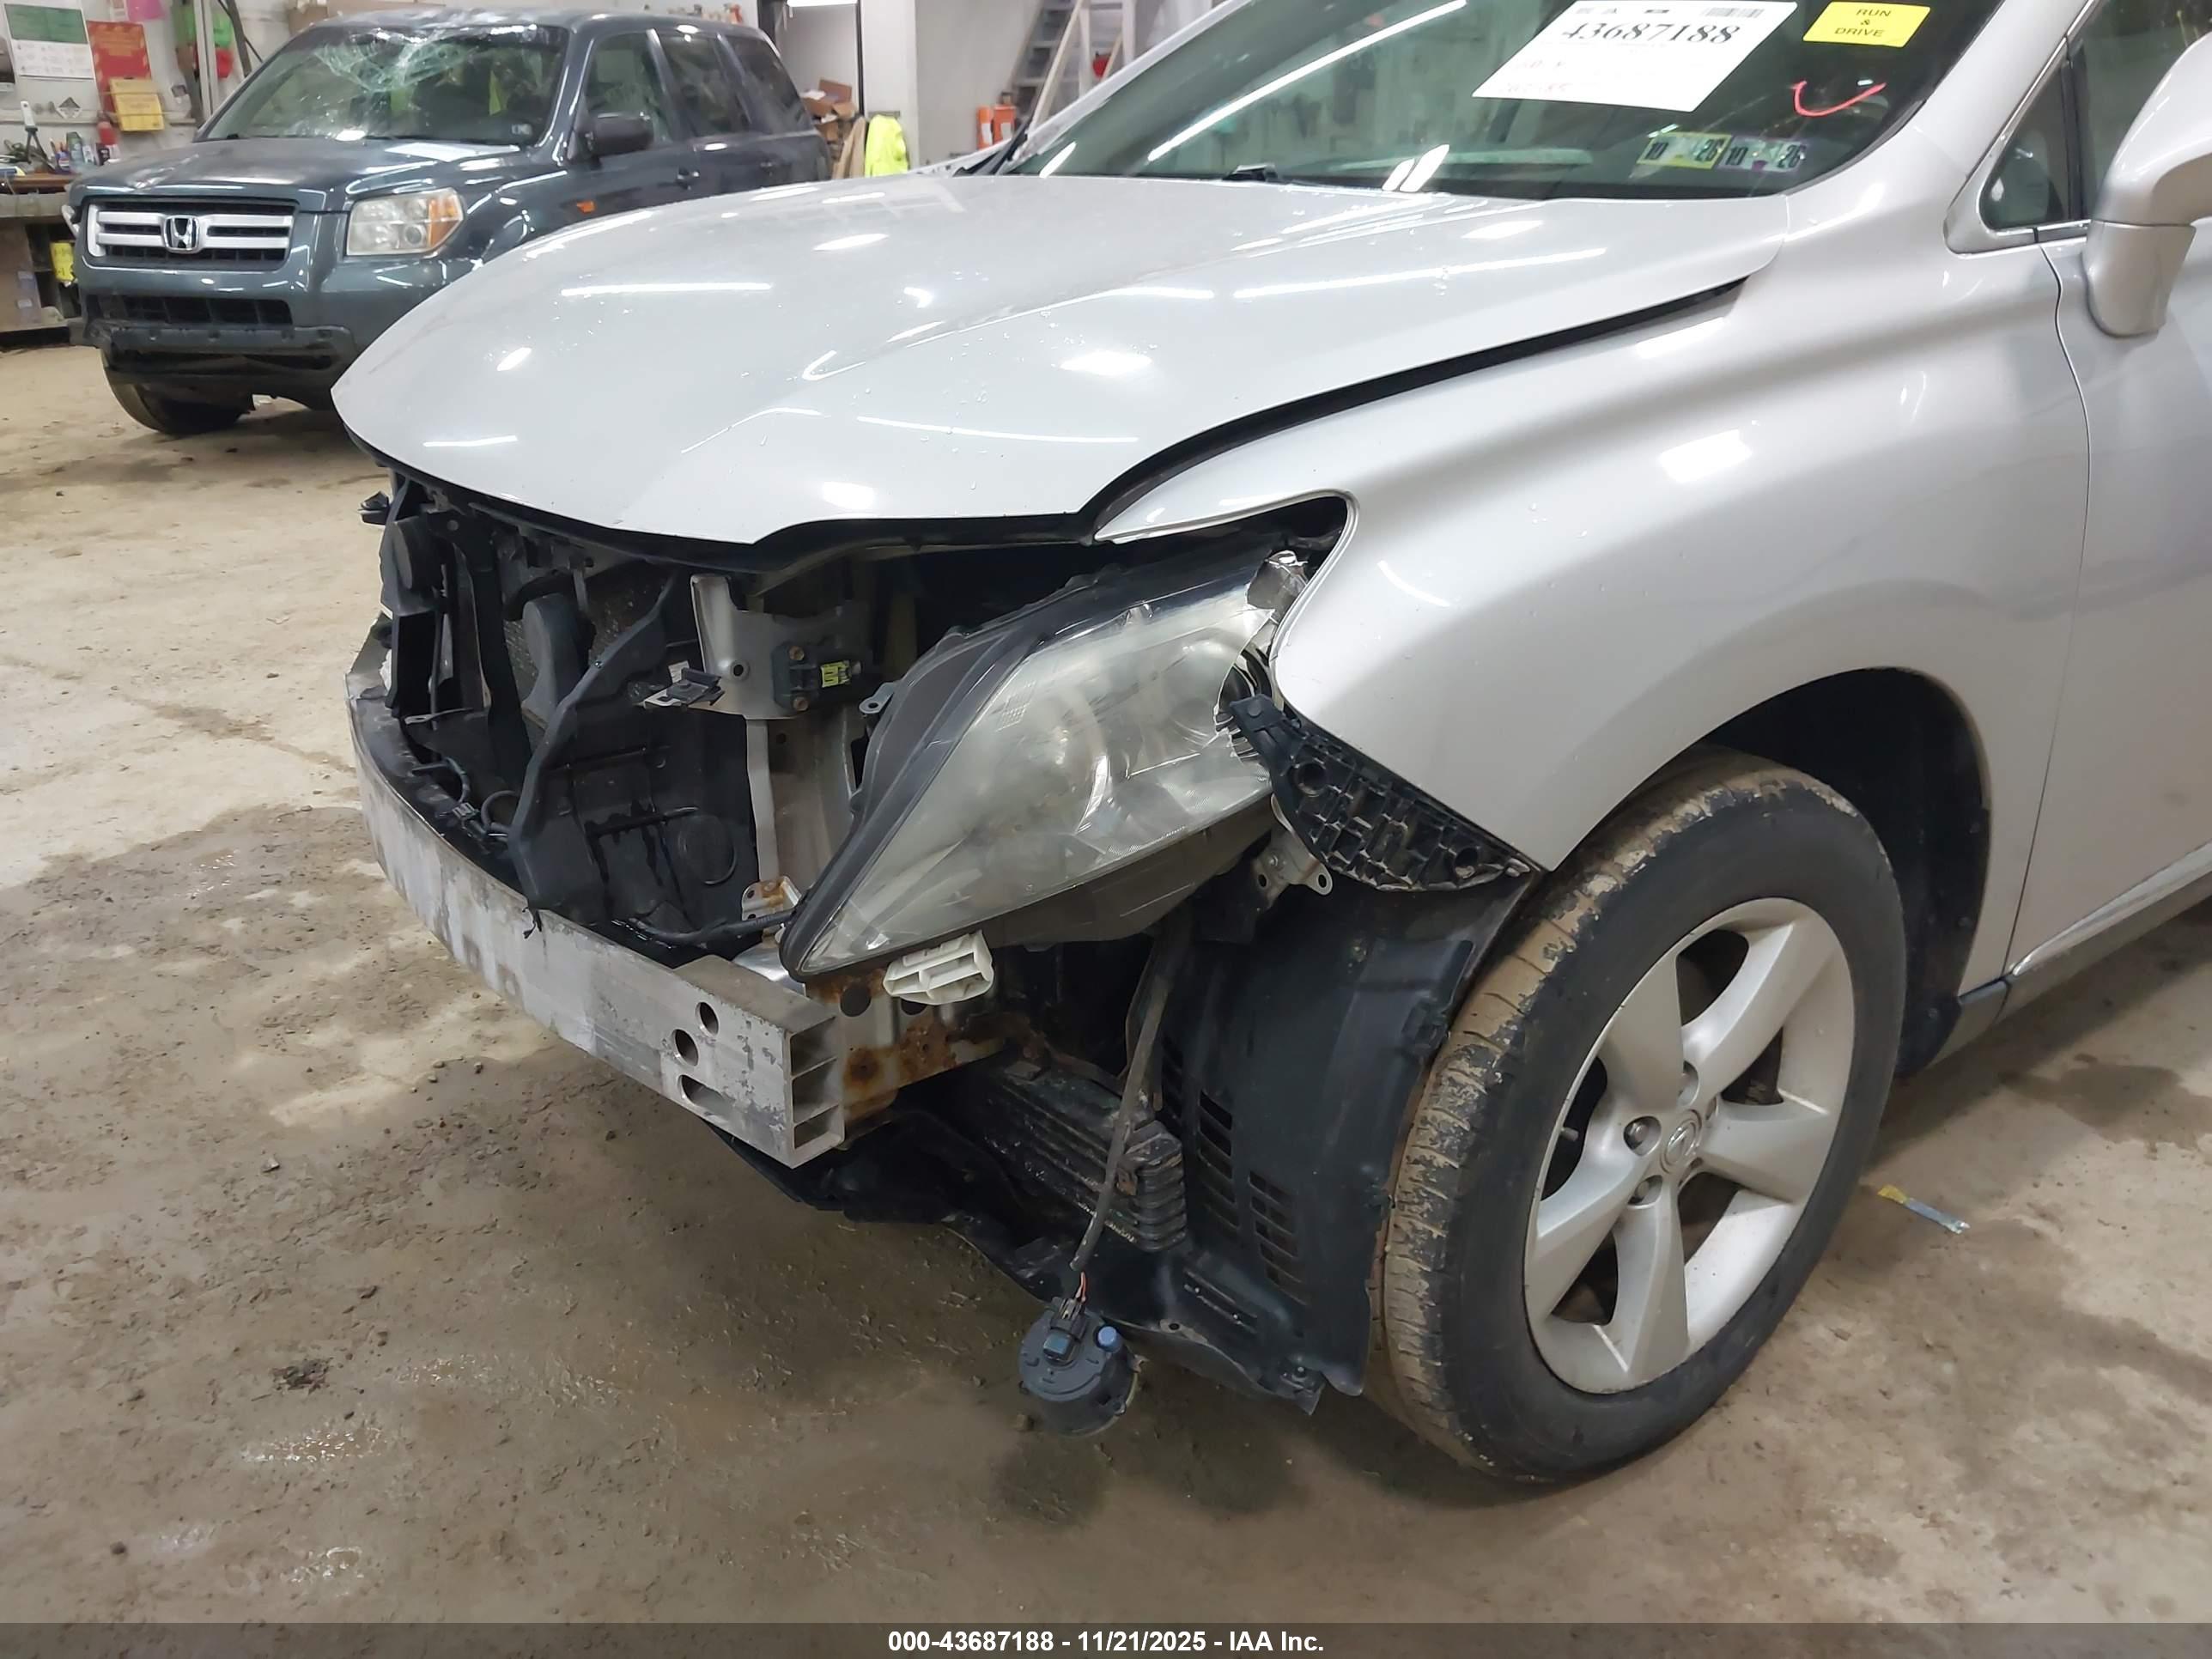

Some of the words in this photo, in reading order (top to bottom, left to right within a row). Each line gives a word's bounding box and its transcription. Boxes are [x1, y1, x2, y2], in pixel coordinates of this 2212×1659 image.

[1856, 9, 1892, 17] RUN
[1561, 21, 1741, 44] 43687188
[1834, 27, 1886, 38] DRIVE
[1644, 141, 1668, 161] 10
